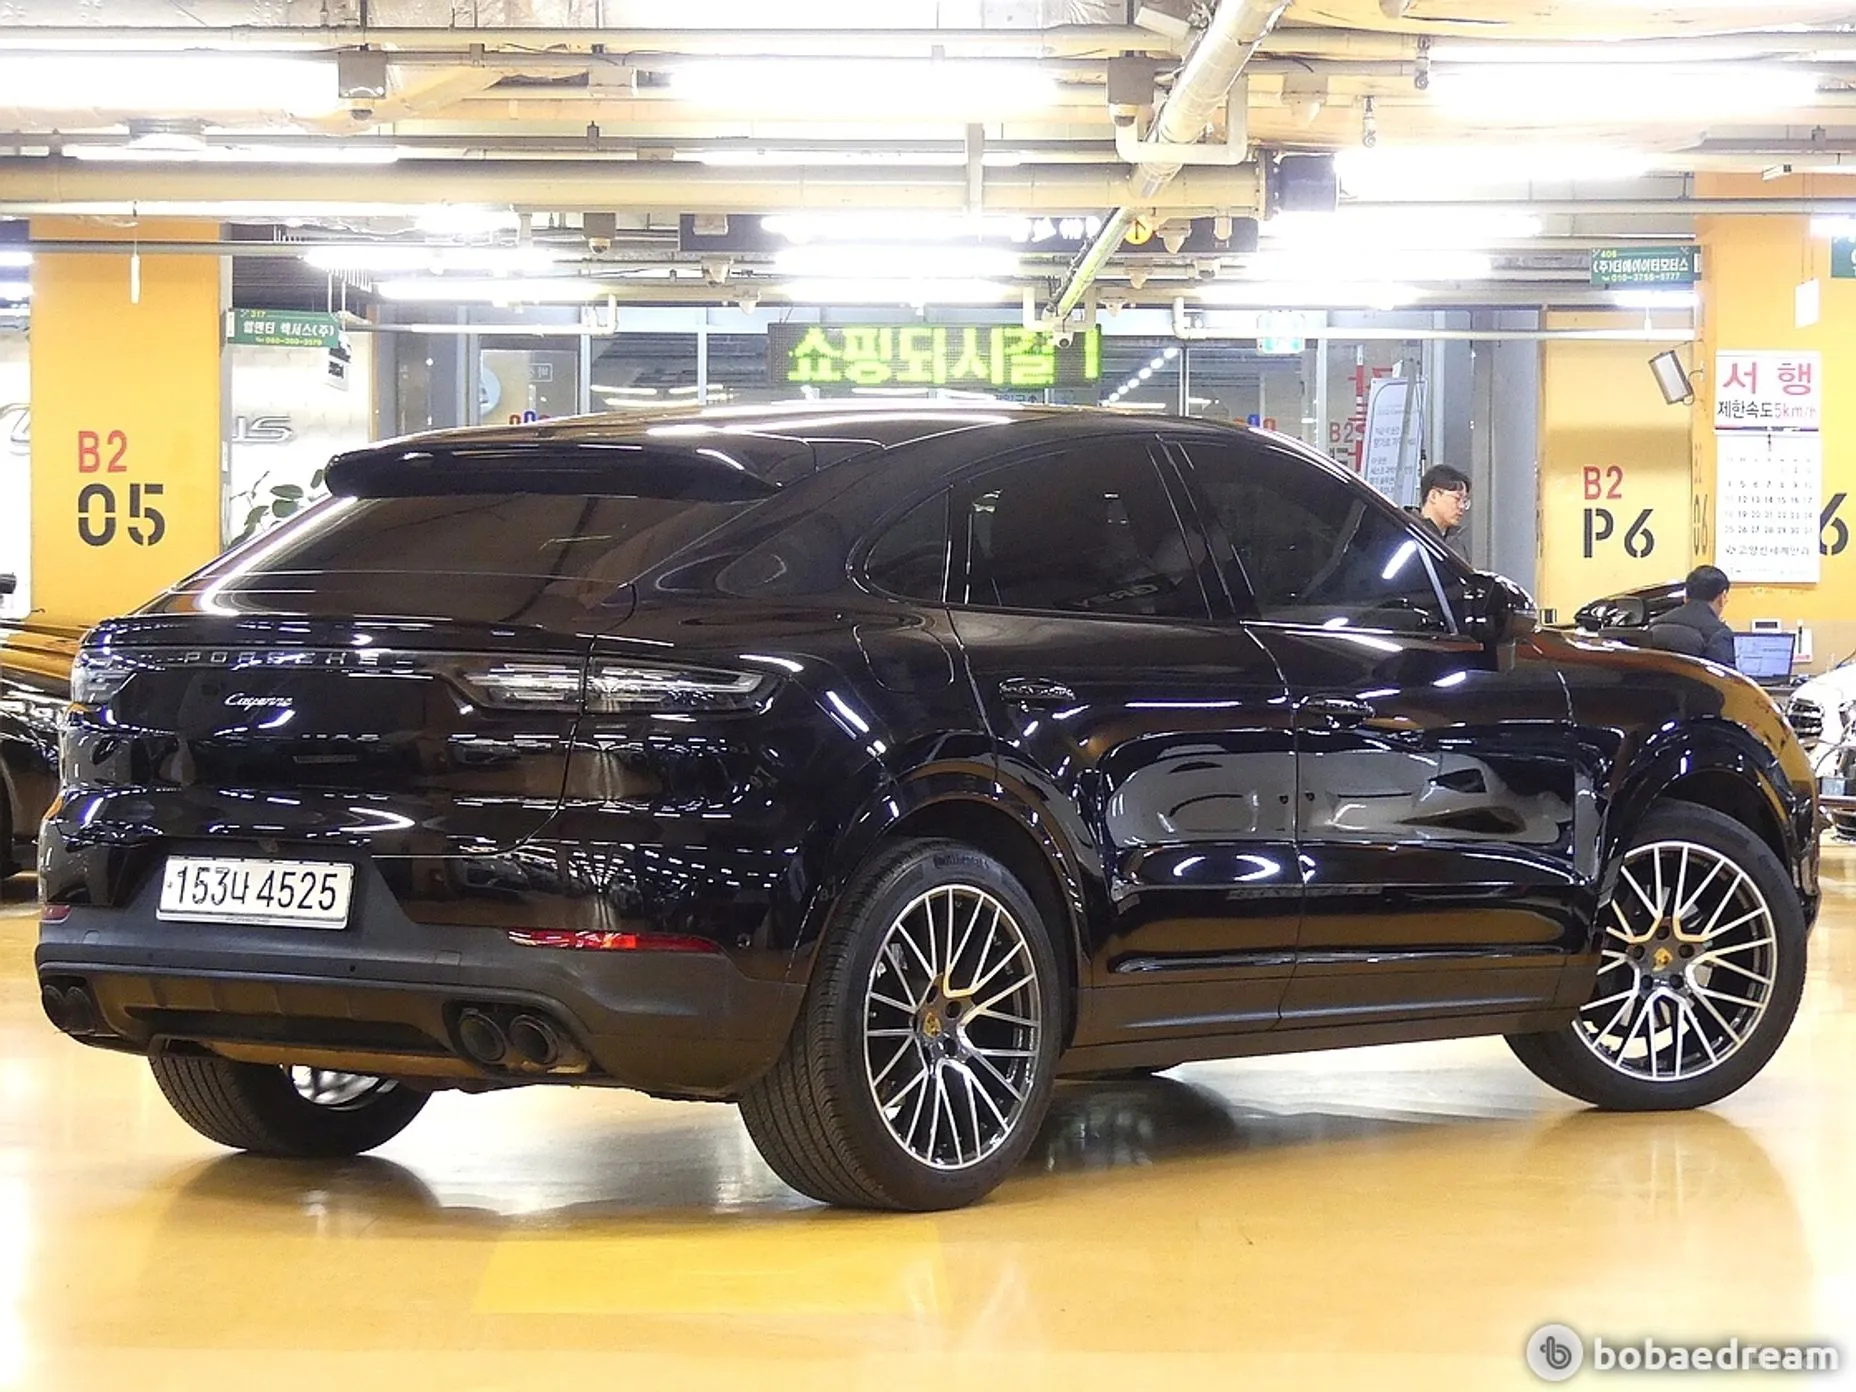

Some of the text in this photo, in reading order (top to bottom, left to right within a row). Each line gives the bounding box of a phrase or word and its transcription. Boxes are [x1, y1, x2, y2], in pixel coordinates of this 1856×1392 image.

[77, 430, 128, 473] B2
[1329, 422, 1354, 444] B2
[1583, 465, 1623, 500] B2
[77, 483, 165, 547] 05
[1583, 508, 1655, 559] P6
[184, 650, 379, 667] PORSCHE
[224, 692, 294, 710] Cayenne
[176, 866, 339, 911] 153나 4525
